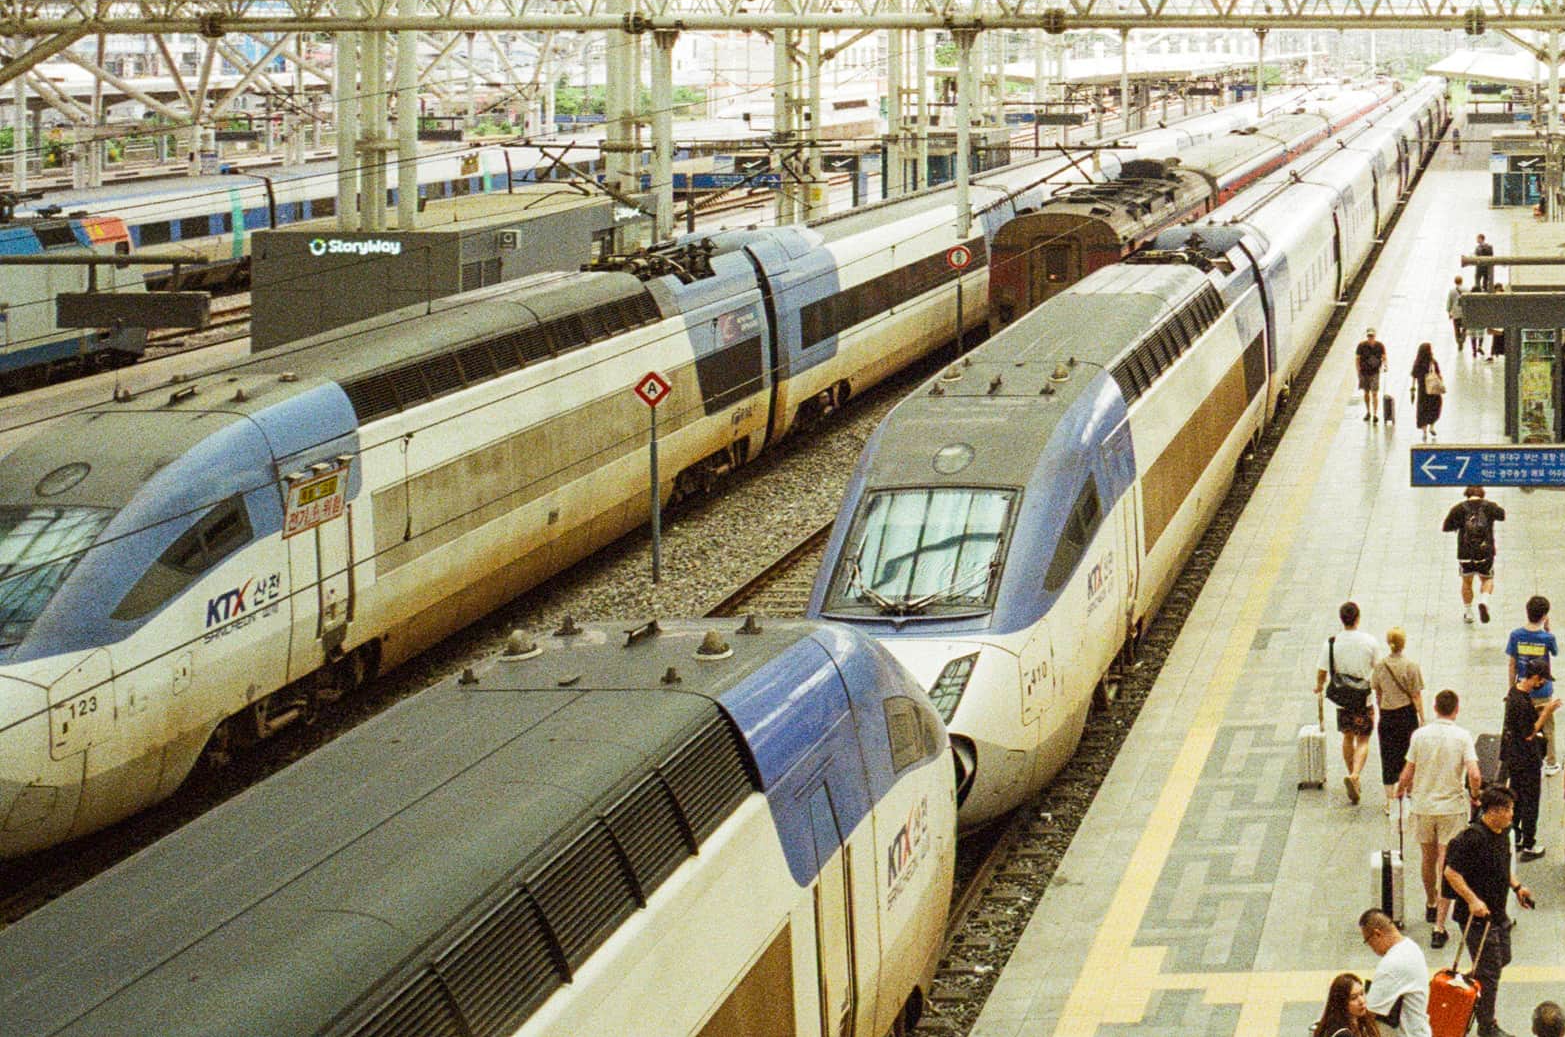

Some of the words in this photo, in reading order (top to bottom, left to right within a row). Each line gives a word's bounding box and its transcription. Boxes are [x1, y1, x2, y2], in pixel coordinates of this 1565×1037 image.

[328, 240, 401, 255] StoryWay
[647, 381, 657, 394] A
[1455, 456, 1471, 479] 7
[1088, 554, 1103, 600] KTX
[206, 577, 253, 628] KTX
[254, 572, 280, 606] 산천
[68, 696, 97, 719] 123
[888, 802, 914, 887] KTX
